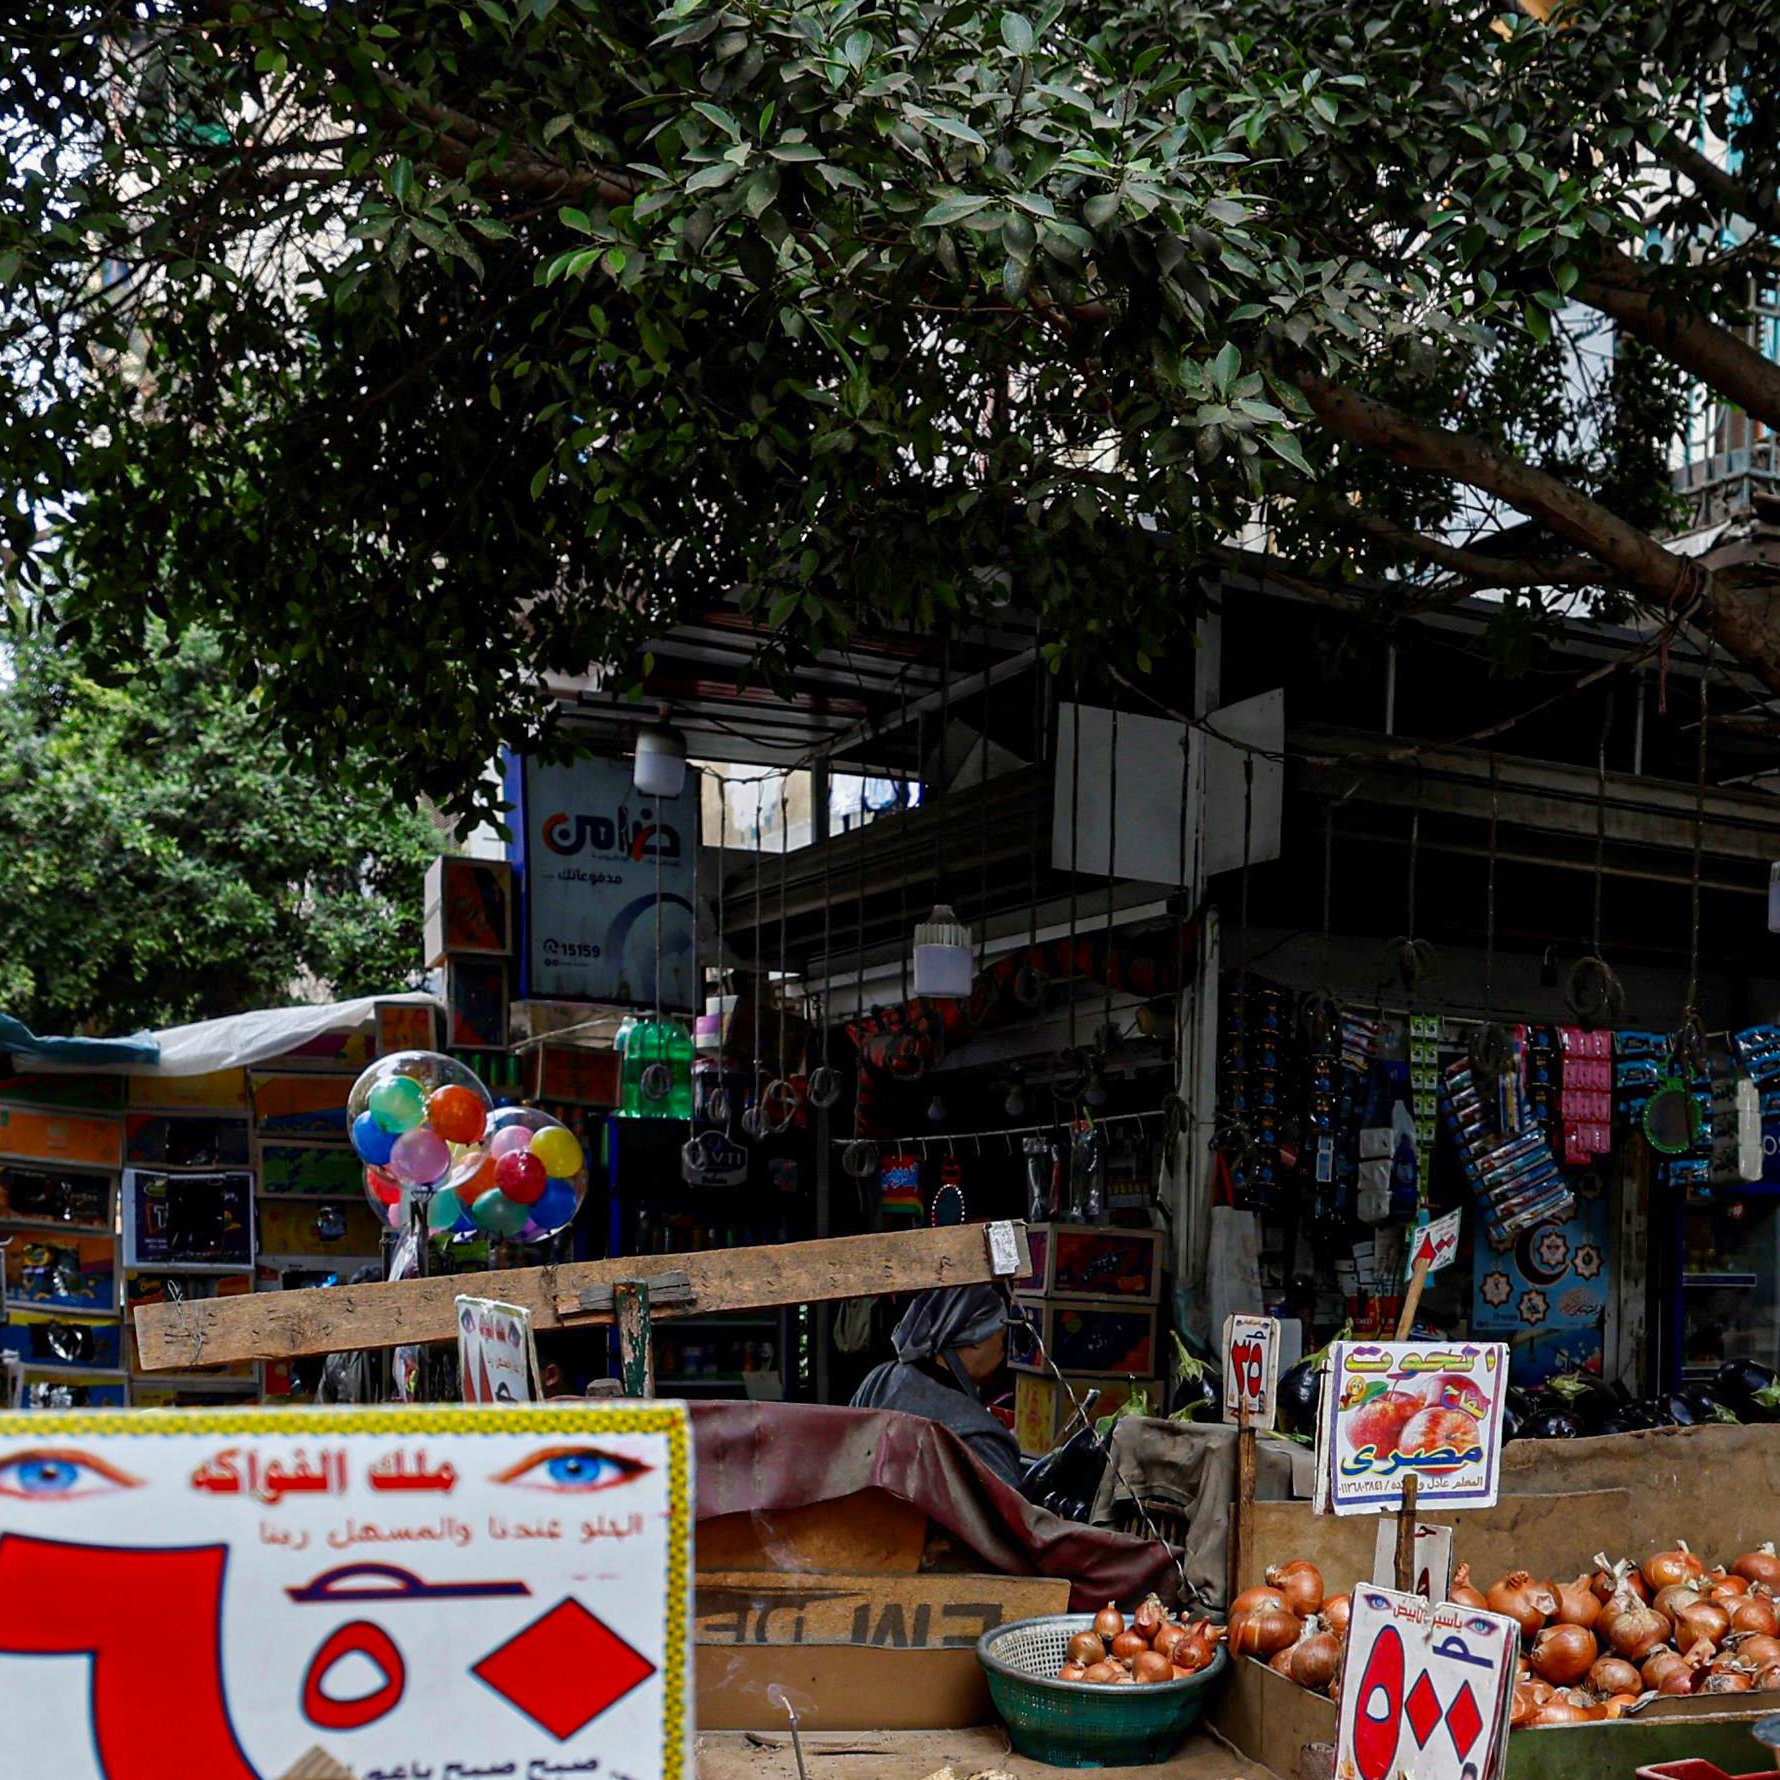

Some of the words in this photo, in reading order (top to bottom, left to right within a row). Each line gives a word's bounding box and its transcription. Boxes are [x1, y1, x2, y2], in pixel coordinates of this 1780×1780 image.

[542, 805, 681, 863] ضامن
[561, 944, 601, 958] 15159
[1231, 1339, 1262, 1397] ٣٥
[368, 1448, 460, 1493] ملك
[487, 1515, 563, 1541] عندنا
